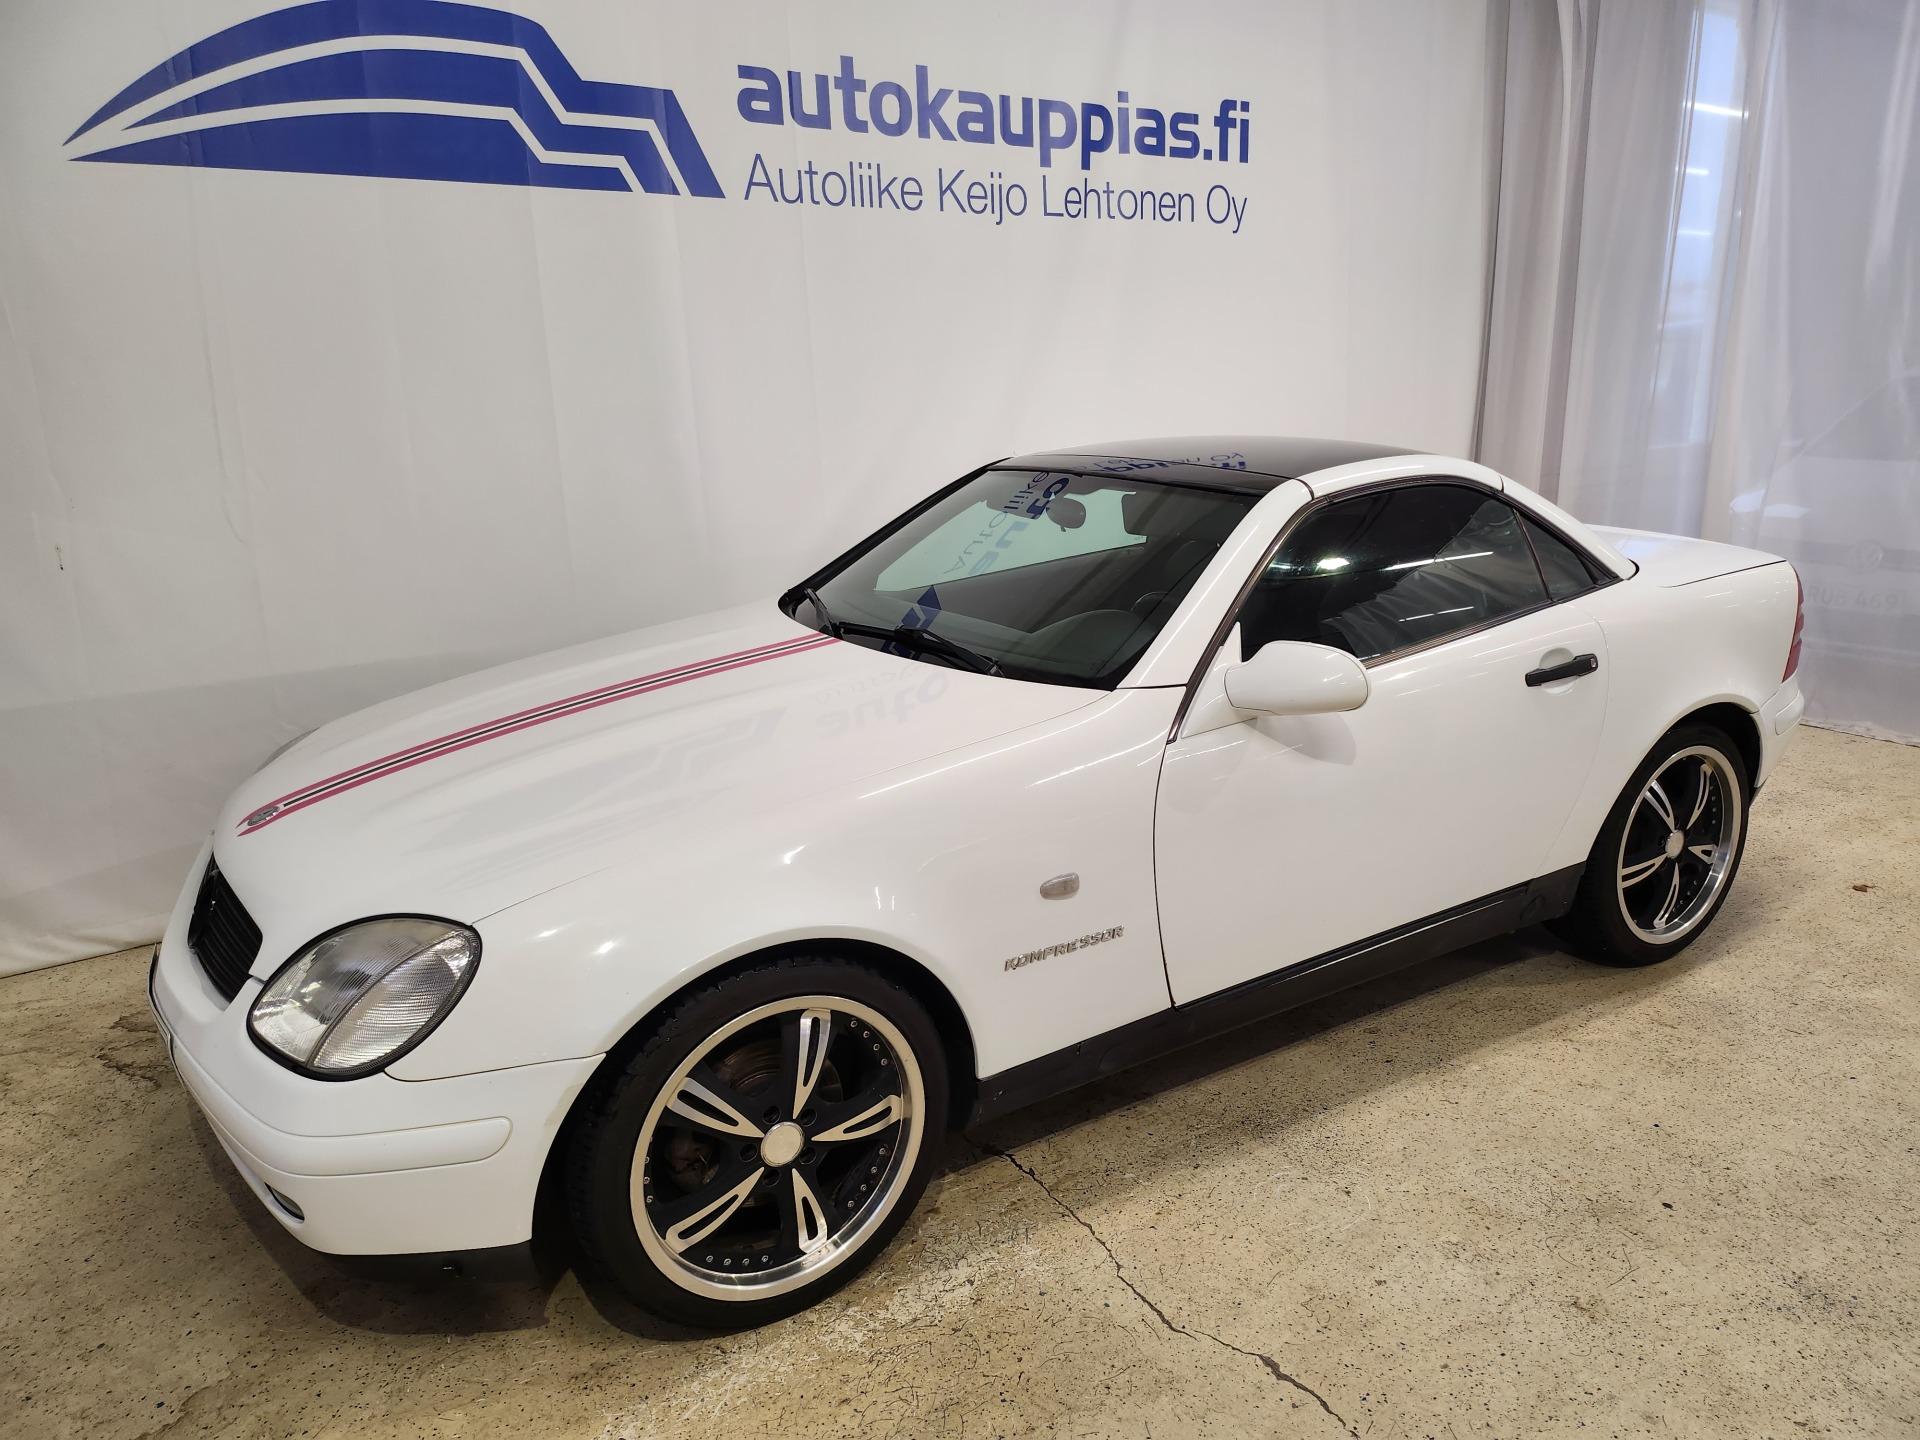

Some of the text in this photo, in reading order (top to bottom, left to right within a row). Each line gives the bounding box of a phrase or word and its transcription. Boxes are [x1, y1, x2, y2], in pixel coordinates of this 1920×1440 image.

[736, 55, 1250, 172] autokauppias.fi
[744, 153, 1248, 234] Autoliike Keijo Lehtonen Oy
[1003, 925, 1125, 972] KOMPRESSOR
